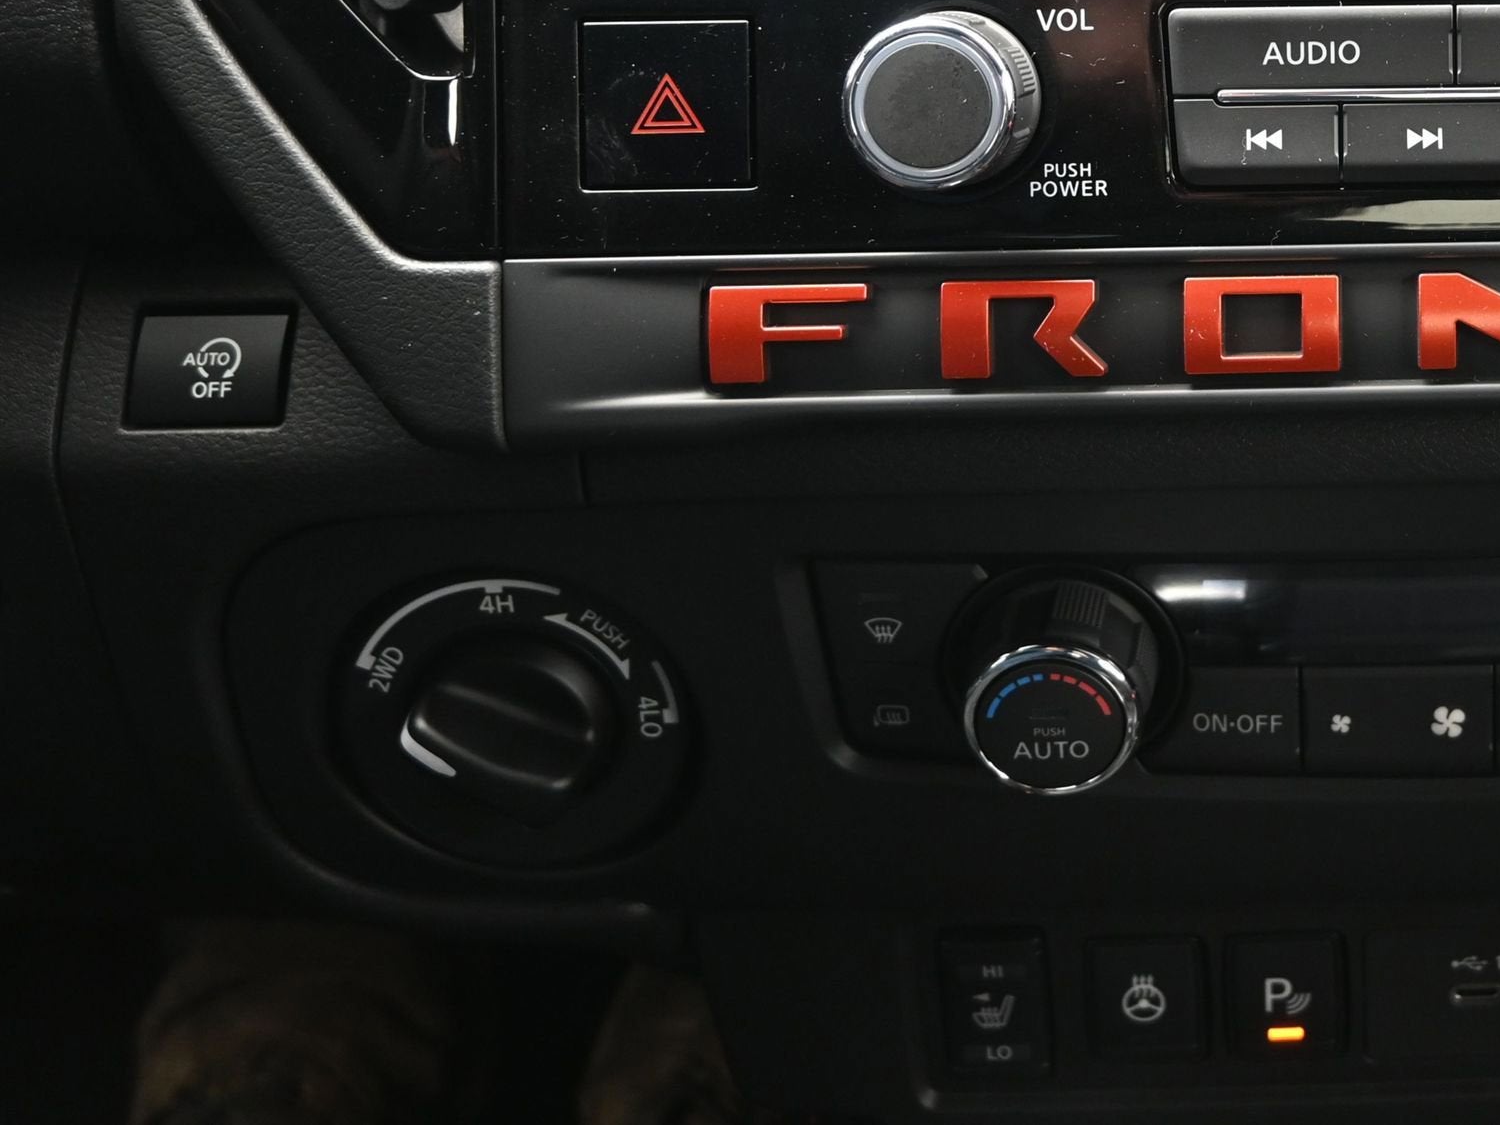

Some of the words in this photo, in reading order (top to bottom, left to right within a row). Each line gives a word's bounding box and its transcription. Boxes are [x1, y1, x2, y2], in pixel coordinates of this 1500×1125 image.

[1036, 8, 1095, 33] VOL
[1261, 39, 1361, 65] AUDIO
[1043, 162, 1092, 178] PUSH
[1029, 179, 1108, 198] POWER
[183, 350, 231, 367] AUTO
[191, 380, 232, 399] OFF
[479, 594, 515, 615] 4H
[579, 608, 630, 651] PUSH
[368, 646, 405, 693] 2WD
[637, 696, 663, 738] 4LO
[1033, 726, 1066, 738] PUSH
[1013, 740, 1090, 760] AUTO
[982, 964, 1004, 978] HI
[986, 1045, 1013, 1060] LO
